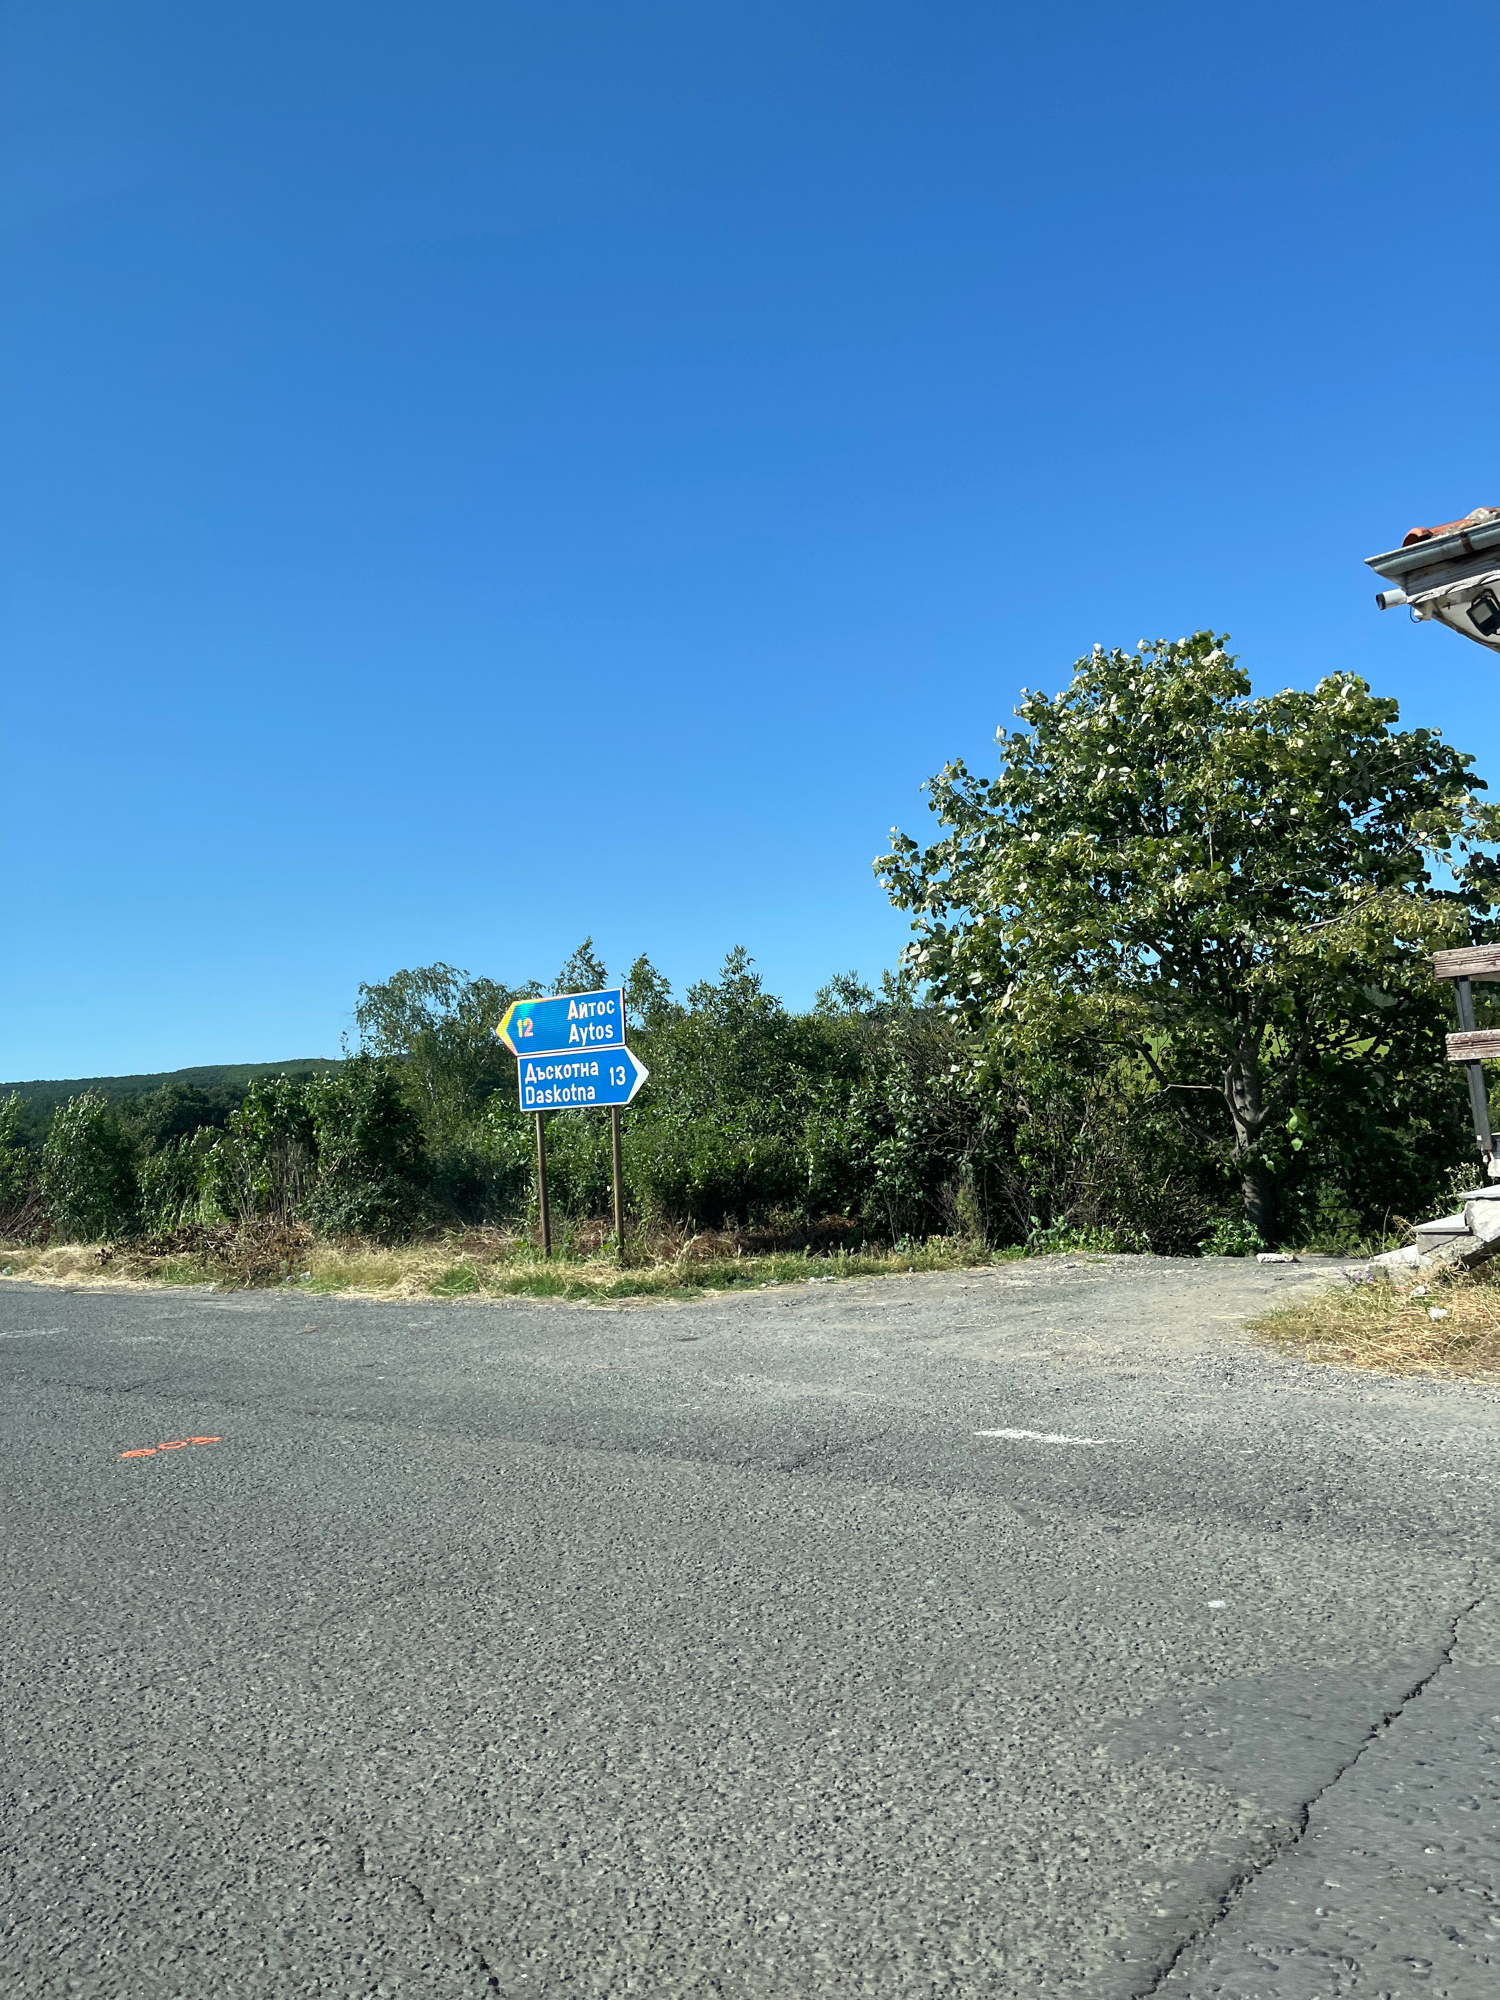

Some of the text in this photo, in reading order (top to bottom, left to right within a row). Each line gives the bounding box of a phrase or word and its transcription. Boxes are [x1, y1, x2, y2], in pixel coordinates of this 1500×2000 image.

[567, 1000, 615, 1021] Айтос
[516, 1018, 534, 1038] 12
[568, 1022, 614, 1046] Aytos
[524, 1061, 599, 1085] Дъскотна
[609, 1066, 626, 1086] 13
[525, 1083, 596, 1105] Daskotna
